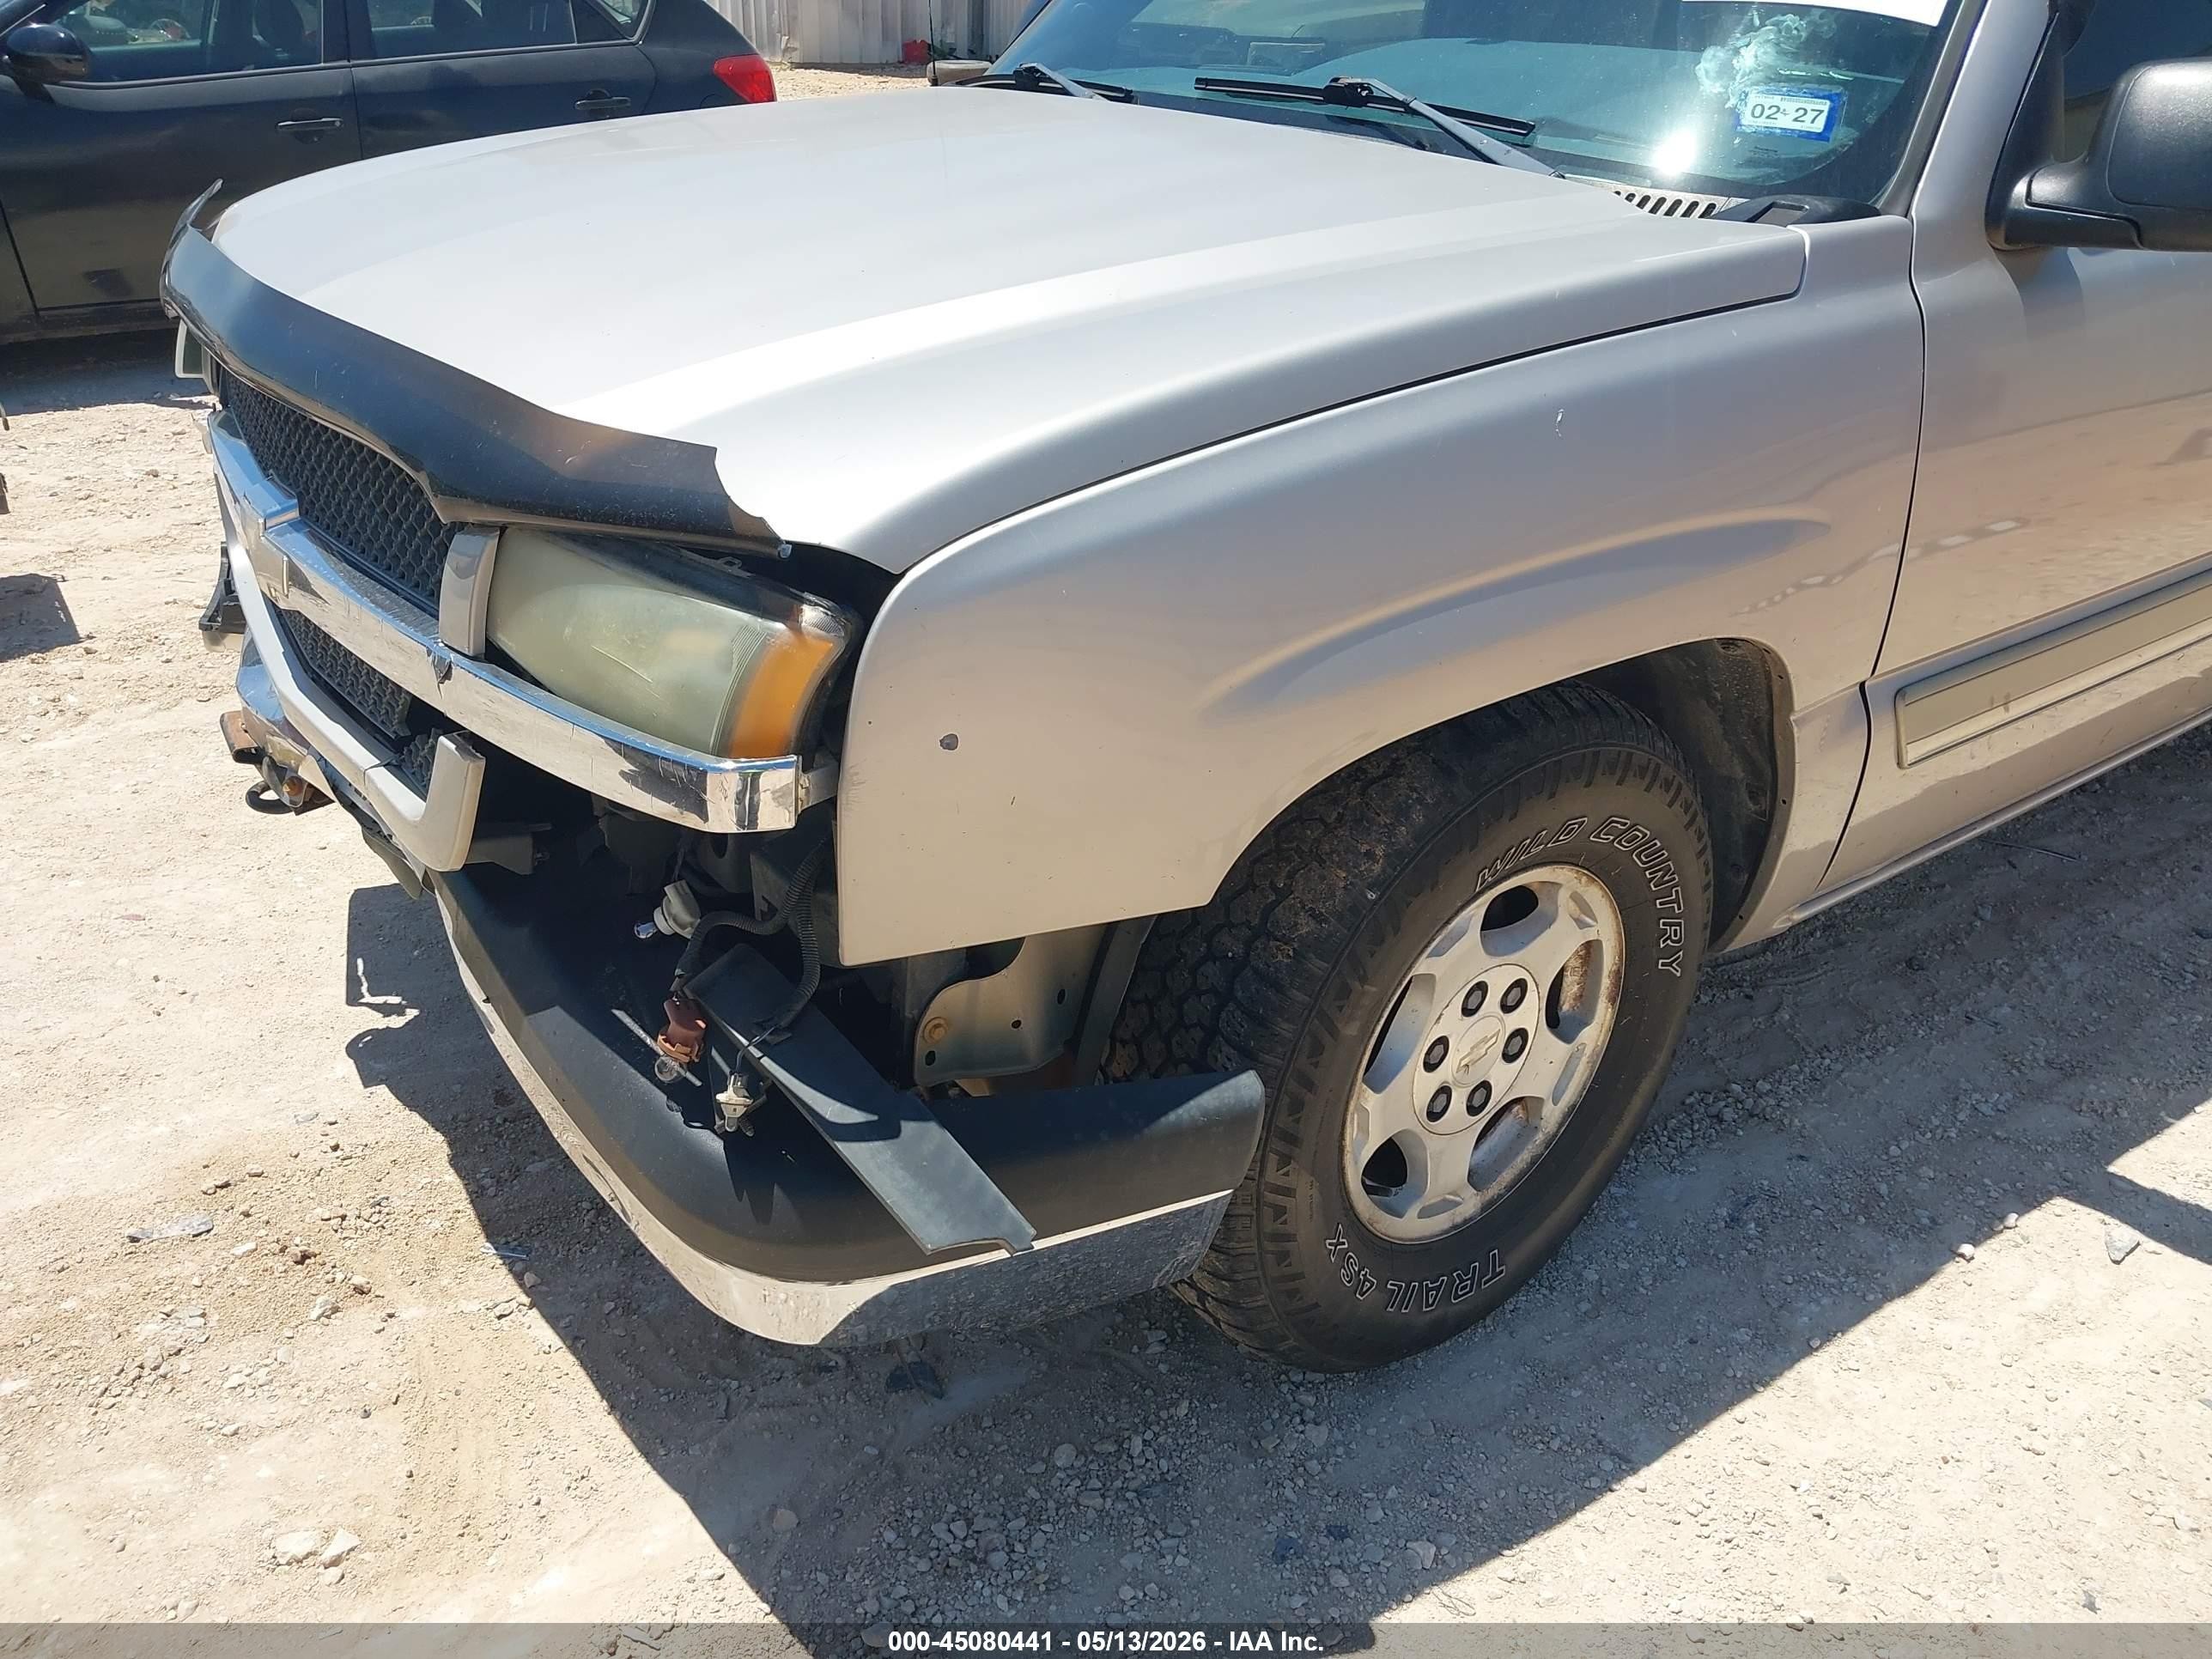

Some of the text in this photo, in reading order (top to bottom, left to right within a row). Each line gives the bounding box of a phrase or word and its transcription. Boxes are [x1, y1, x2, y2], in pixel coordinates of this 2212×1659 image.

[1750, 103, 1826, 125] 02 27
[1475, 817, 1685, 978] WILD COUNTRY
[1325, 1222, 1506, 1313] TRAIL 4SX
